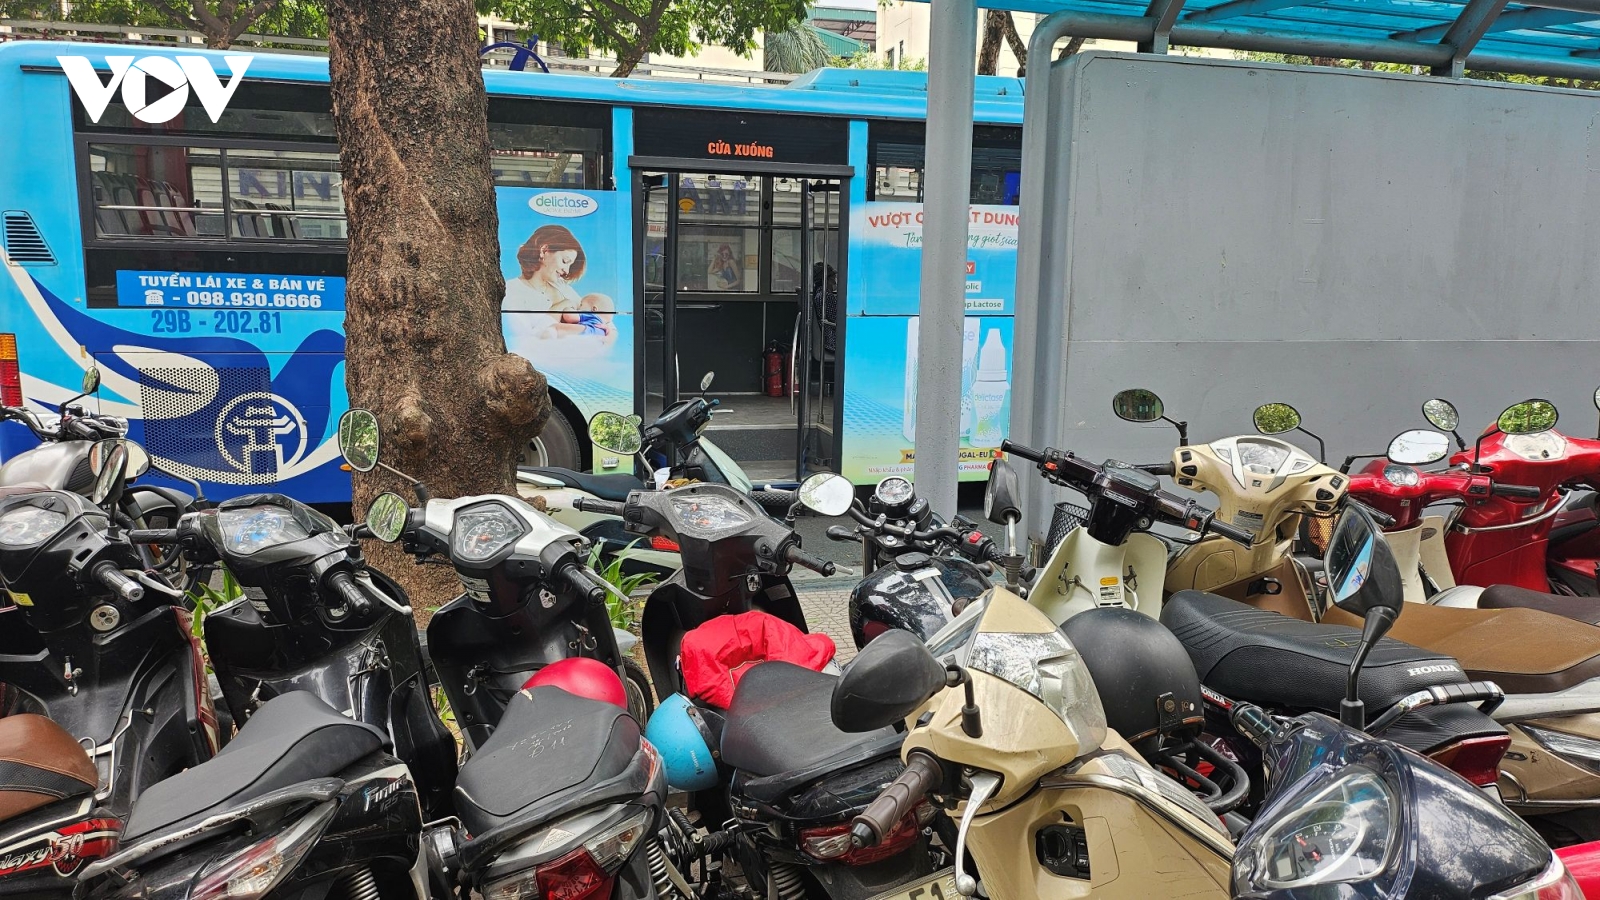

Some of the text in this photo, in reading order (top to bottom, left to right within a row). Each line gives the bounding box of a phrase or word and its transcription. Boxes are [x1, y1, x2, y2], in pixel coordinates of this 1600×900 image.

[708, 140, 774, 158] CỬA XUỐNG
[535, 195, 589, 208] delictase
[868, 212, 912, 228] VƯỢT
[138, 272, 326, 291] TUYỂN LÁI XE & BÁN VÉ
[186, 291, 322, 308] 098.930.6666
[151, 310, 192, 333] 29B
[214, 310, 282, 334] 202.81
[1406, 664, 1460, 676] HONDA
[49, 832, 86, 862] 50
